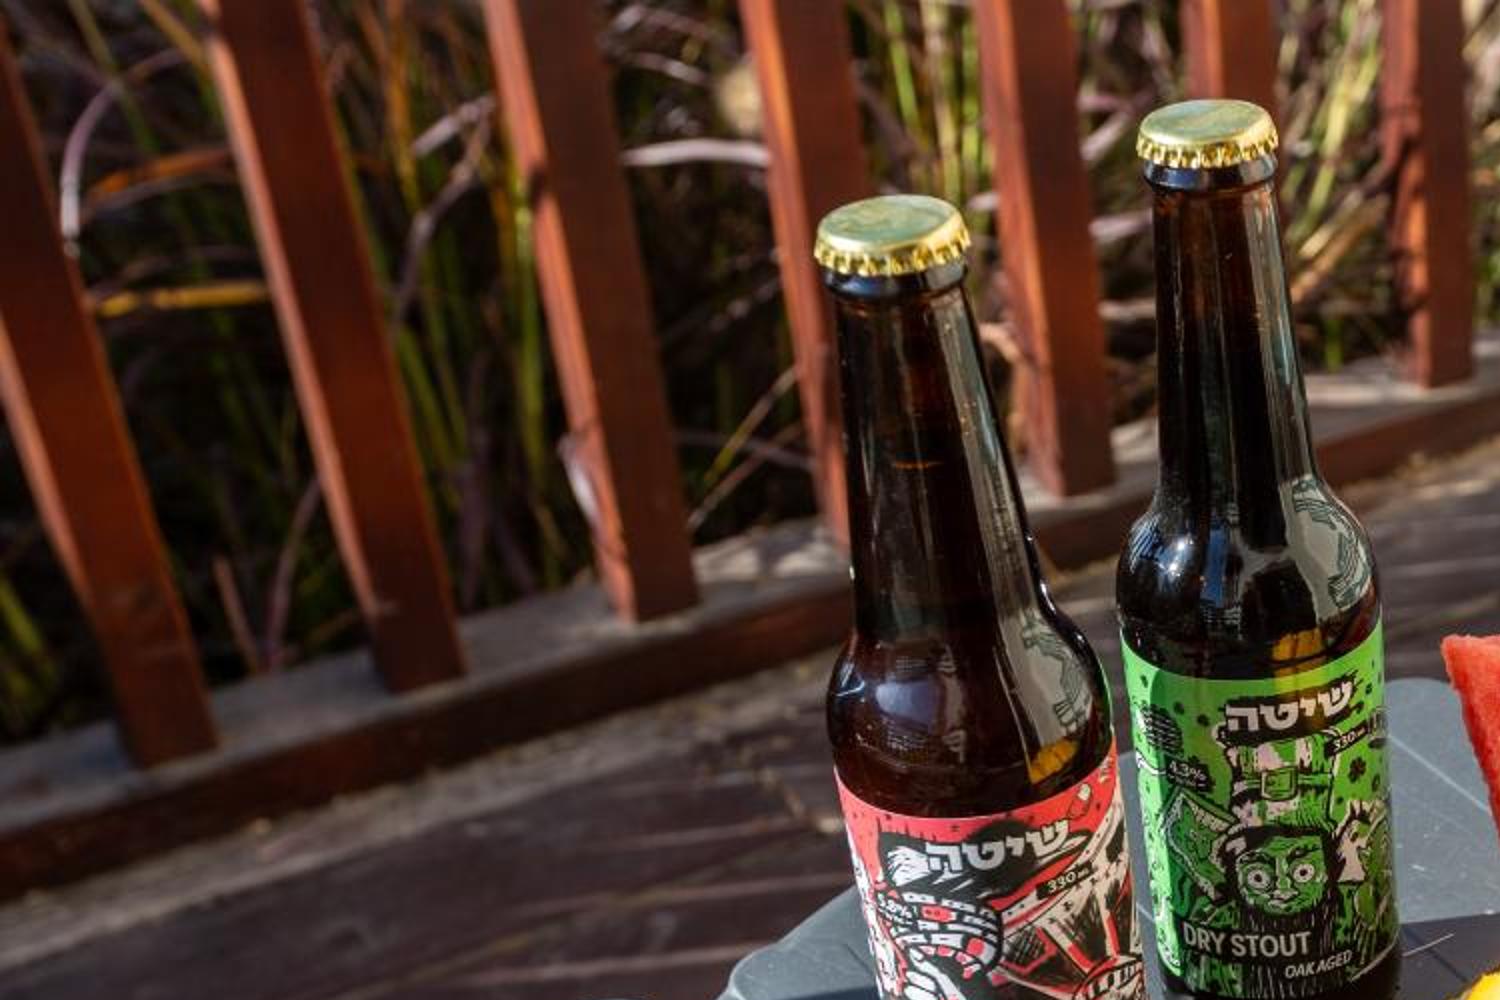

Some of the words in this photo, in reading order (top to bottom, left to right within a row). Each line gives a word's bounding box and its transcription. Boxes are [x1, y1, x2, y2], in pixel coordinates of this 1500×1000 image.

[1226, 681, 1353, 731] שיטה
[926, 820, 1069, 871] שיטה
[1182, 921, 1225, 953] DRY
[1230, 931, 1312, 957] STOUT
[1285, 964, 1314, 979] OAK
[1316, 950, 1352, 973] AGED
